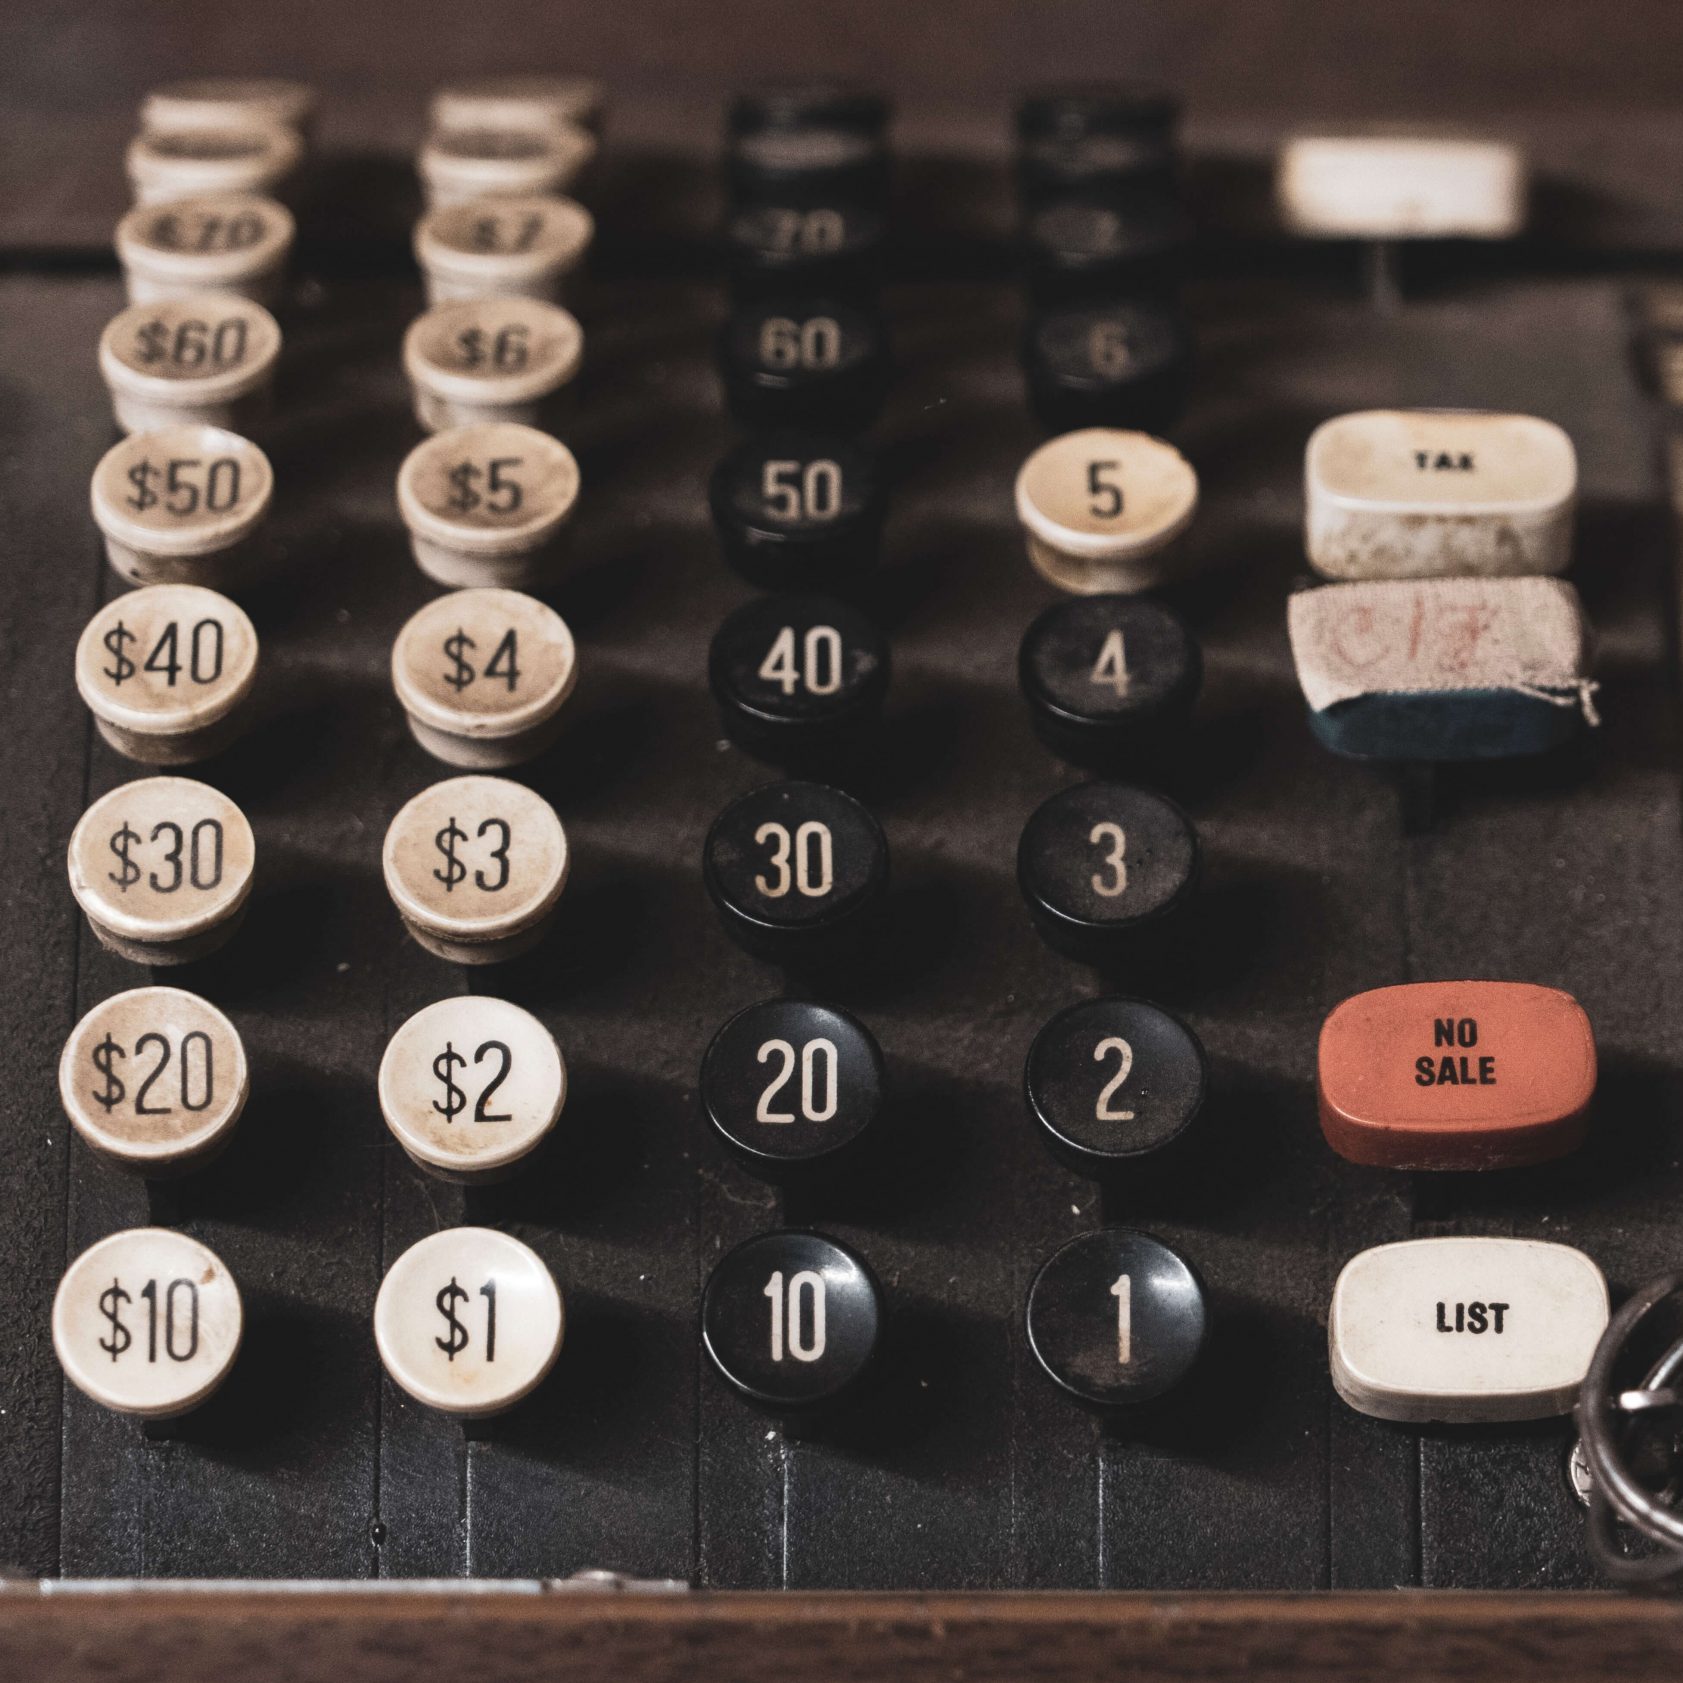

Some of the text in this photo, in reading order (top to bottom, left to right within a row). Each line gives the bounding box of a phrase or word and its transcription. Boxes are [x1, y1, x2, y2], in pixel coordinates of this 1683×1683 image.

[135, 317, 249, 367] $60
[457, 323, 530, 372] $6
[759, 317, 841, 370] 60
[1088, 322, 1128, 377] 6
[126, 456, 241, 517] $50
[446, 456, 524, 515] $5
[761, 458, 843, 521] 50
[1086, 460, 1125, 519] 5
[1414, 450, 1474, 471] TAX
[103, 618, 224, 688] $40
[443, 627, 522, 693] $4
[758, 625, 843, 696] 40
[1090, 629, 1131, 698] 4
[108, 818, 224, 895] $30
[432, 817, 512, 893] $3
[754, 821, 834, 898] 30
[1089, 822, 1128, 897] 3
[1434, 1018, 1478, 1049] NO
[91, 1030, 214, 1115] $20
[432, 1039, 513, 1124] $2
[756, 1037, 839, 1124] 20
[1093, 1037, 1135, 1121] 2
[1415, 1056, 1497, 1087] SALE
[98, 1277, 200, 1363] $10
[435, 1277, 497, 1362] $1
[763, 1270, 827, 1362] 10
[1109, 1274, 1132, 1364] 1
[1436, 1301, 1511, 1336] LIST
